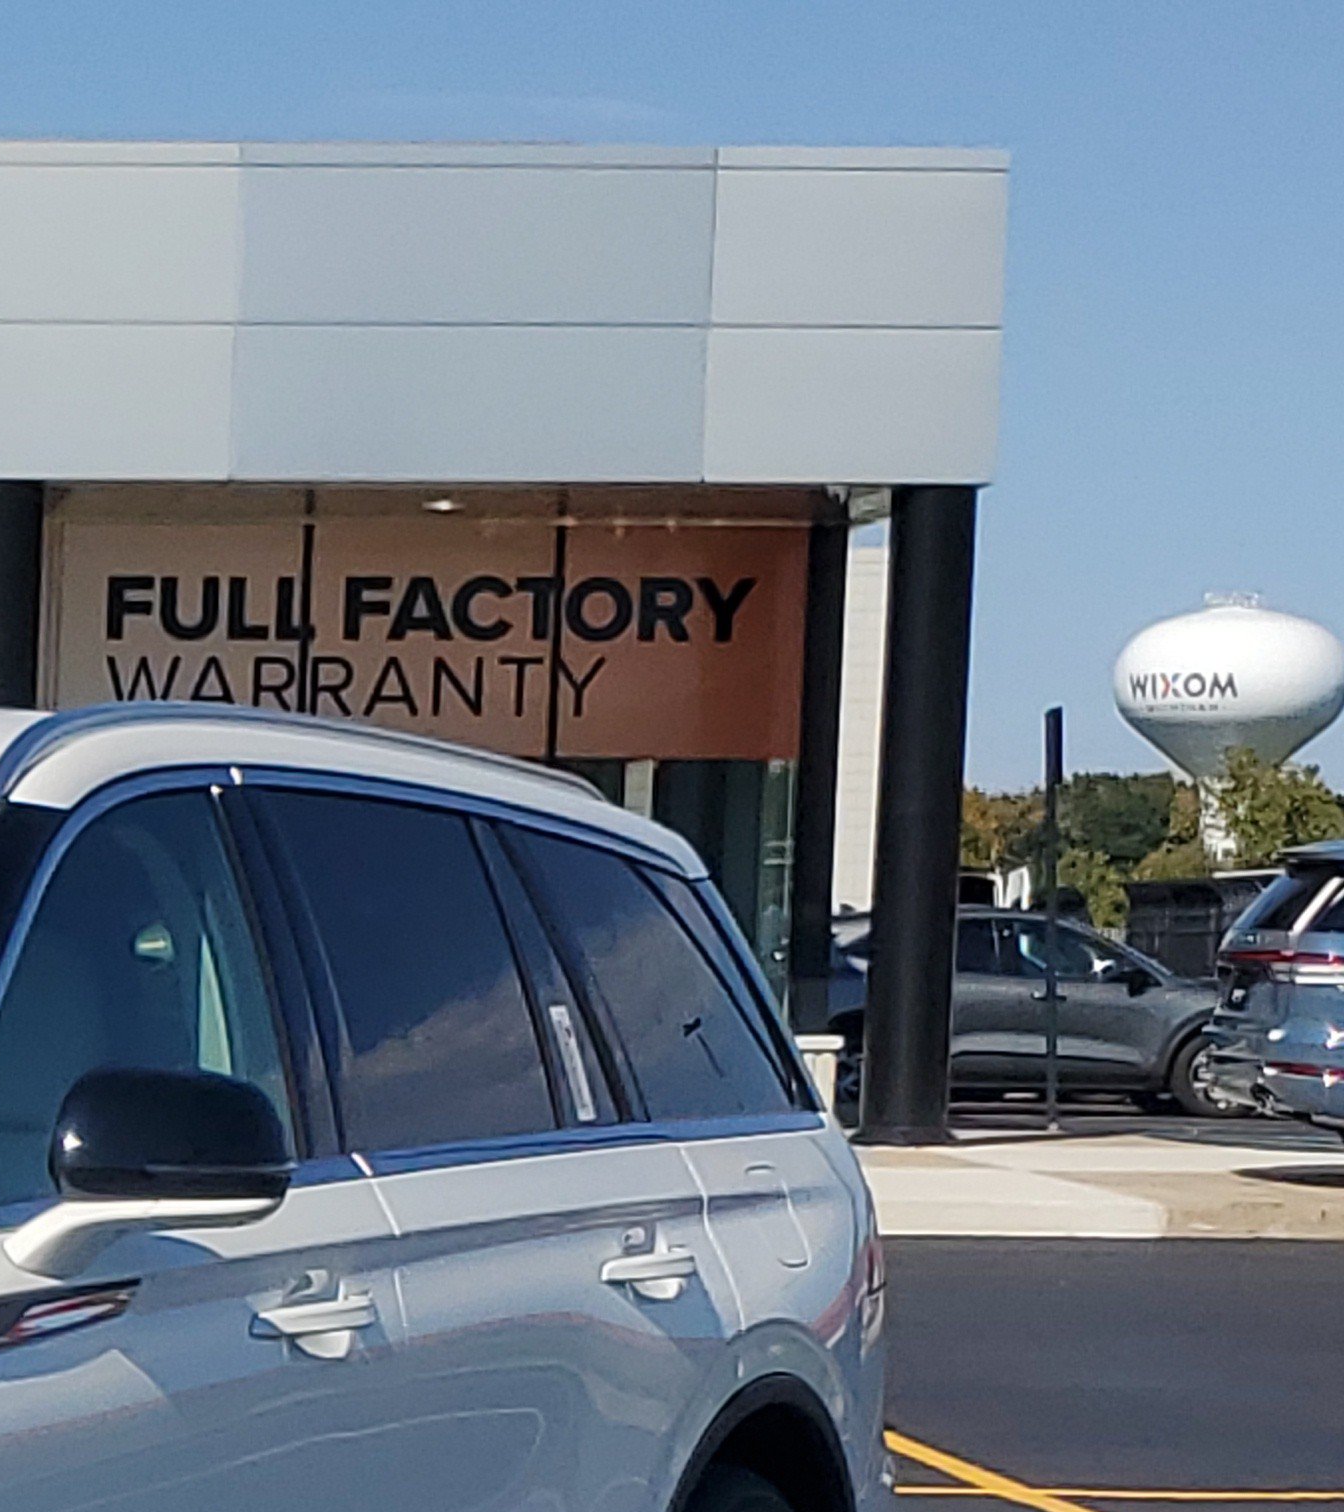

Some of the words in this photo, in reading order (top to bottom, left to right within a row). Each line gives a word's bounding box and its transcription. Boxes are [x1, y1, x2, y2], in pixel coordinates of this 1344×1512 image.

[107, 576, 315, 641] FULL
[343, 575, 757, 642] FACTORY
[107, 655, 606, 717] WARRANTY
[1129, 672, 1238, 700] WIXOM
